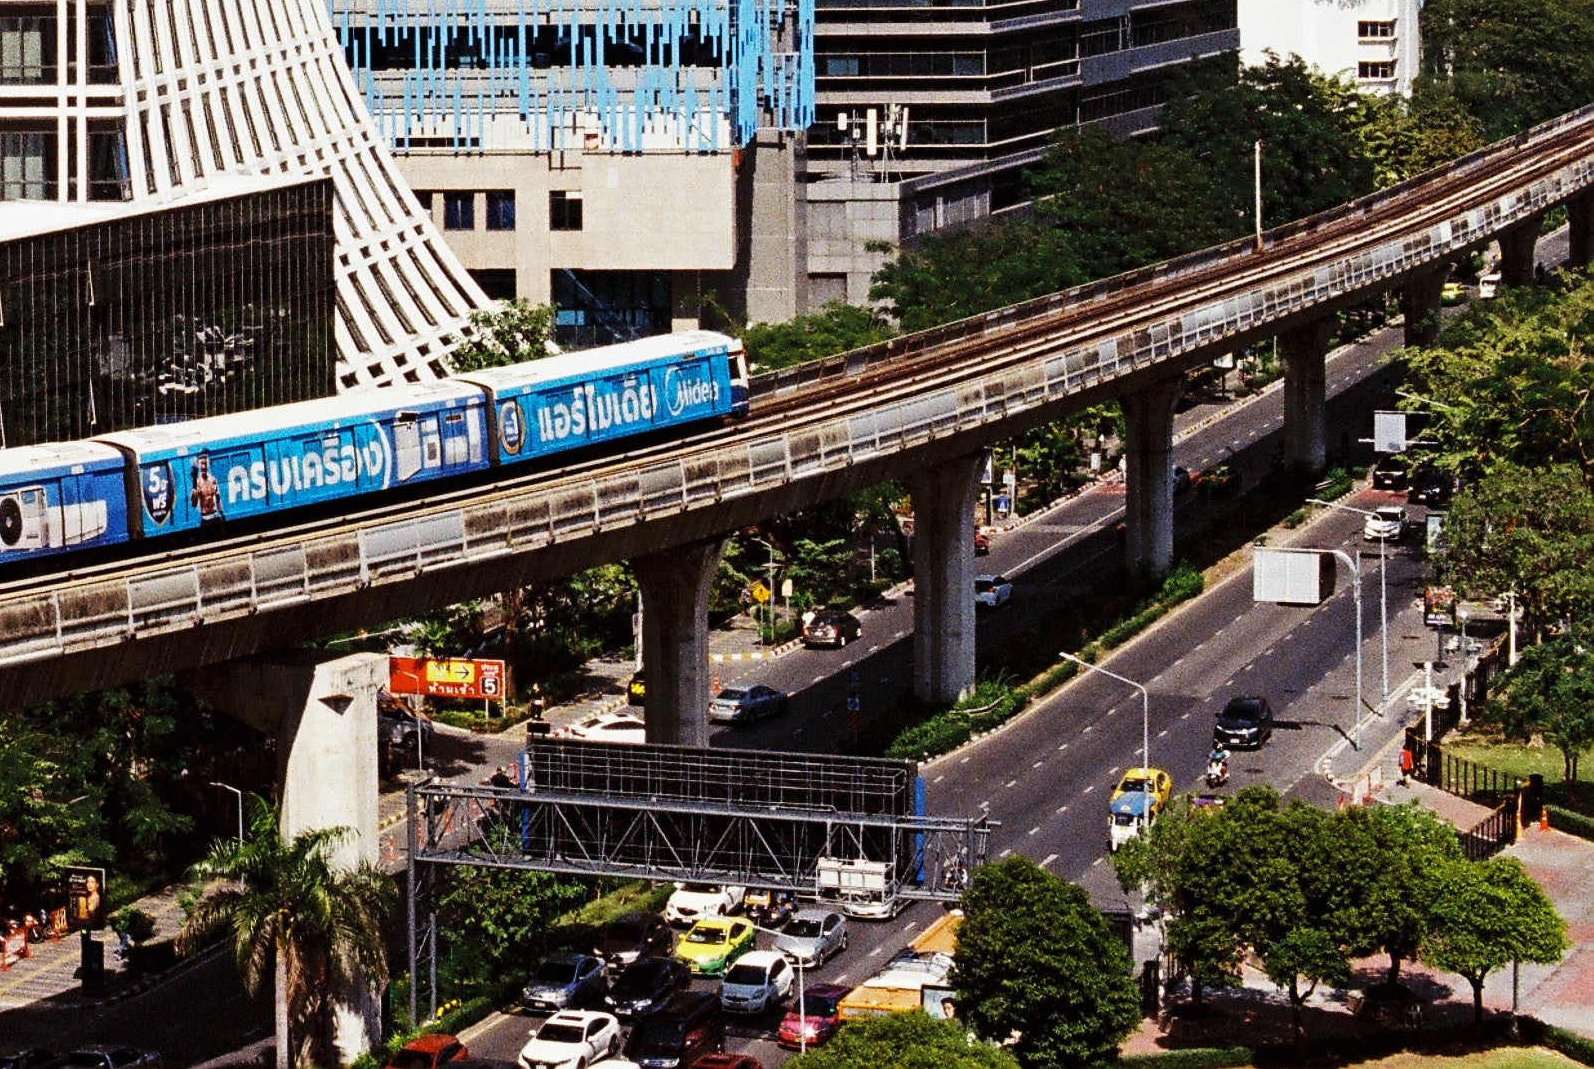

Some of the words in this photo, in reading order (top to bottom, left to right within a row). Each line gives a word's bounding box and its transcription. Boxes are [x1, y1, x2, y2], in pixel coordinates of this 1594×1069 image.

[538, 378, 656, 441] แอร์ไมเดีย
[228, 422, 383, 504] ครบเครื่อง
[429, 682, 475, 694] ห้ามเข้า
[485, 679, 496, 694] 5
